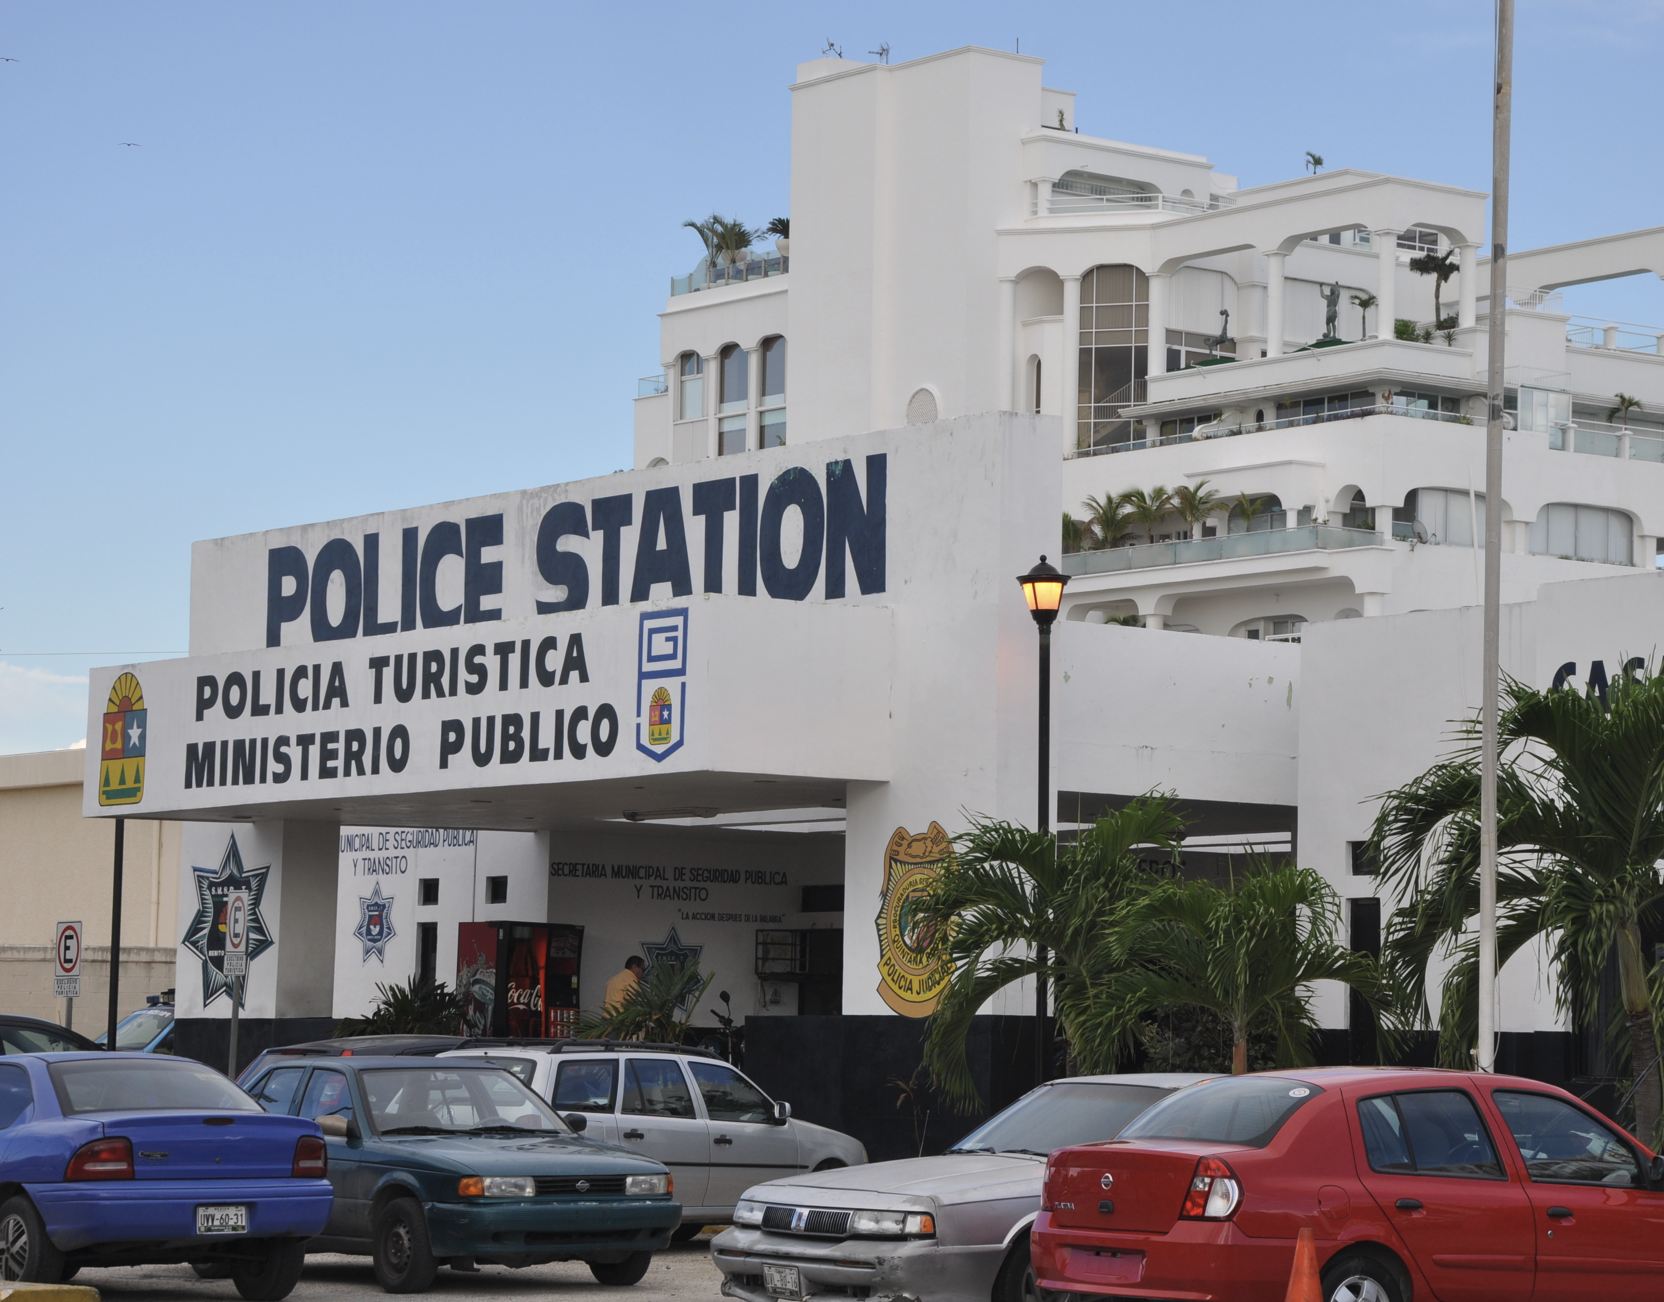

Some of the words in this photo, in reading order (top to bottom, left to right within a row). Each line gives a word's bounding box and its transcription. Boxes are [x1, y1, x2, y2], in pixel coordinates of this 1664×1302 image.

[266, 513, 504, 647] POLICE
[535, 453, 887, 615] STATION
[195, 661, 349, 722] POLICIA
[368, 633, 590, 704] TURISTICA
[184, 724, 410, 789] MINISTERIO
[440, 703, 619, 769] PUBLICO
[378, 832, 390, 851] DE
[393, 829, 440, 850] SEGURIDAD
[353, 859, 359, 876] Y
[361, 856, 408, 876] TRANSITO
[550, 862, 608, 879] SECRETARIA
[611, 865, 669, 881] MUNICIPAL
[673, 866, 686, 881] DE
[689, 868, 741, 884] SEGURIDAD
[744, 869, 788, 886] PUBLICA
[634, 884, 643, 899] Y
[649, 885, 709, 901] TRANSITO
[233, 906, 242, 938] E
[64, 935, 74, 963] E
[883, 957, 914, 996] POLICIA
[200, 1213, 243, 1226] UVV-60-31
